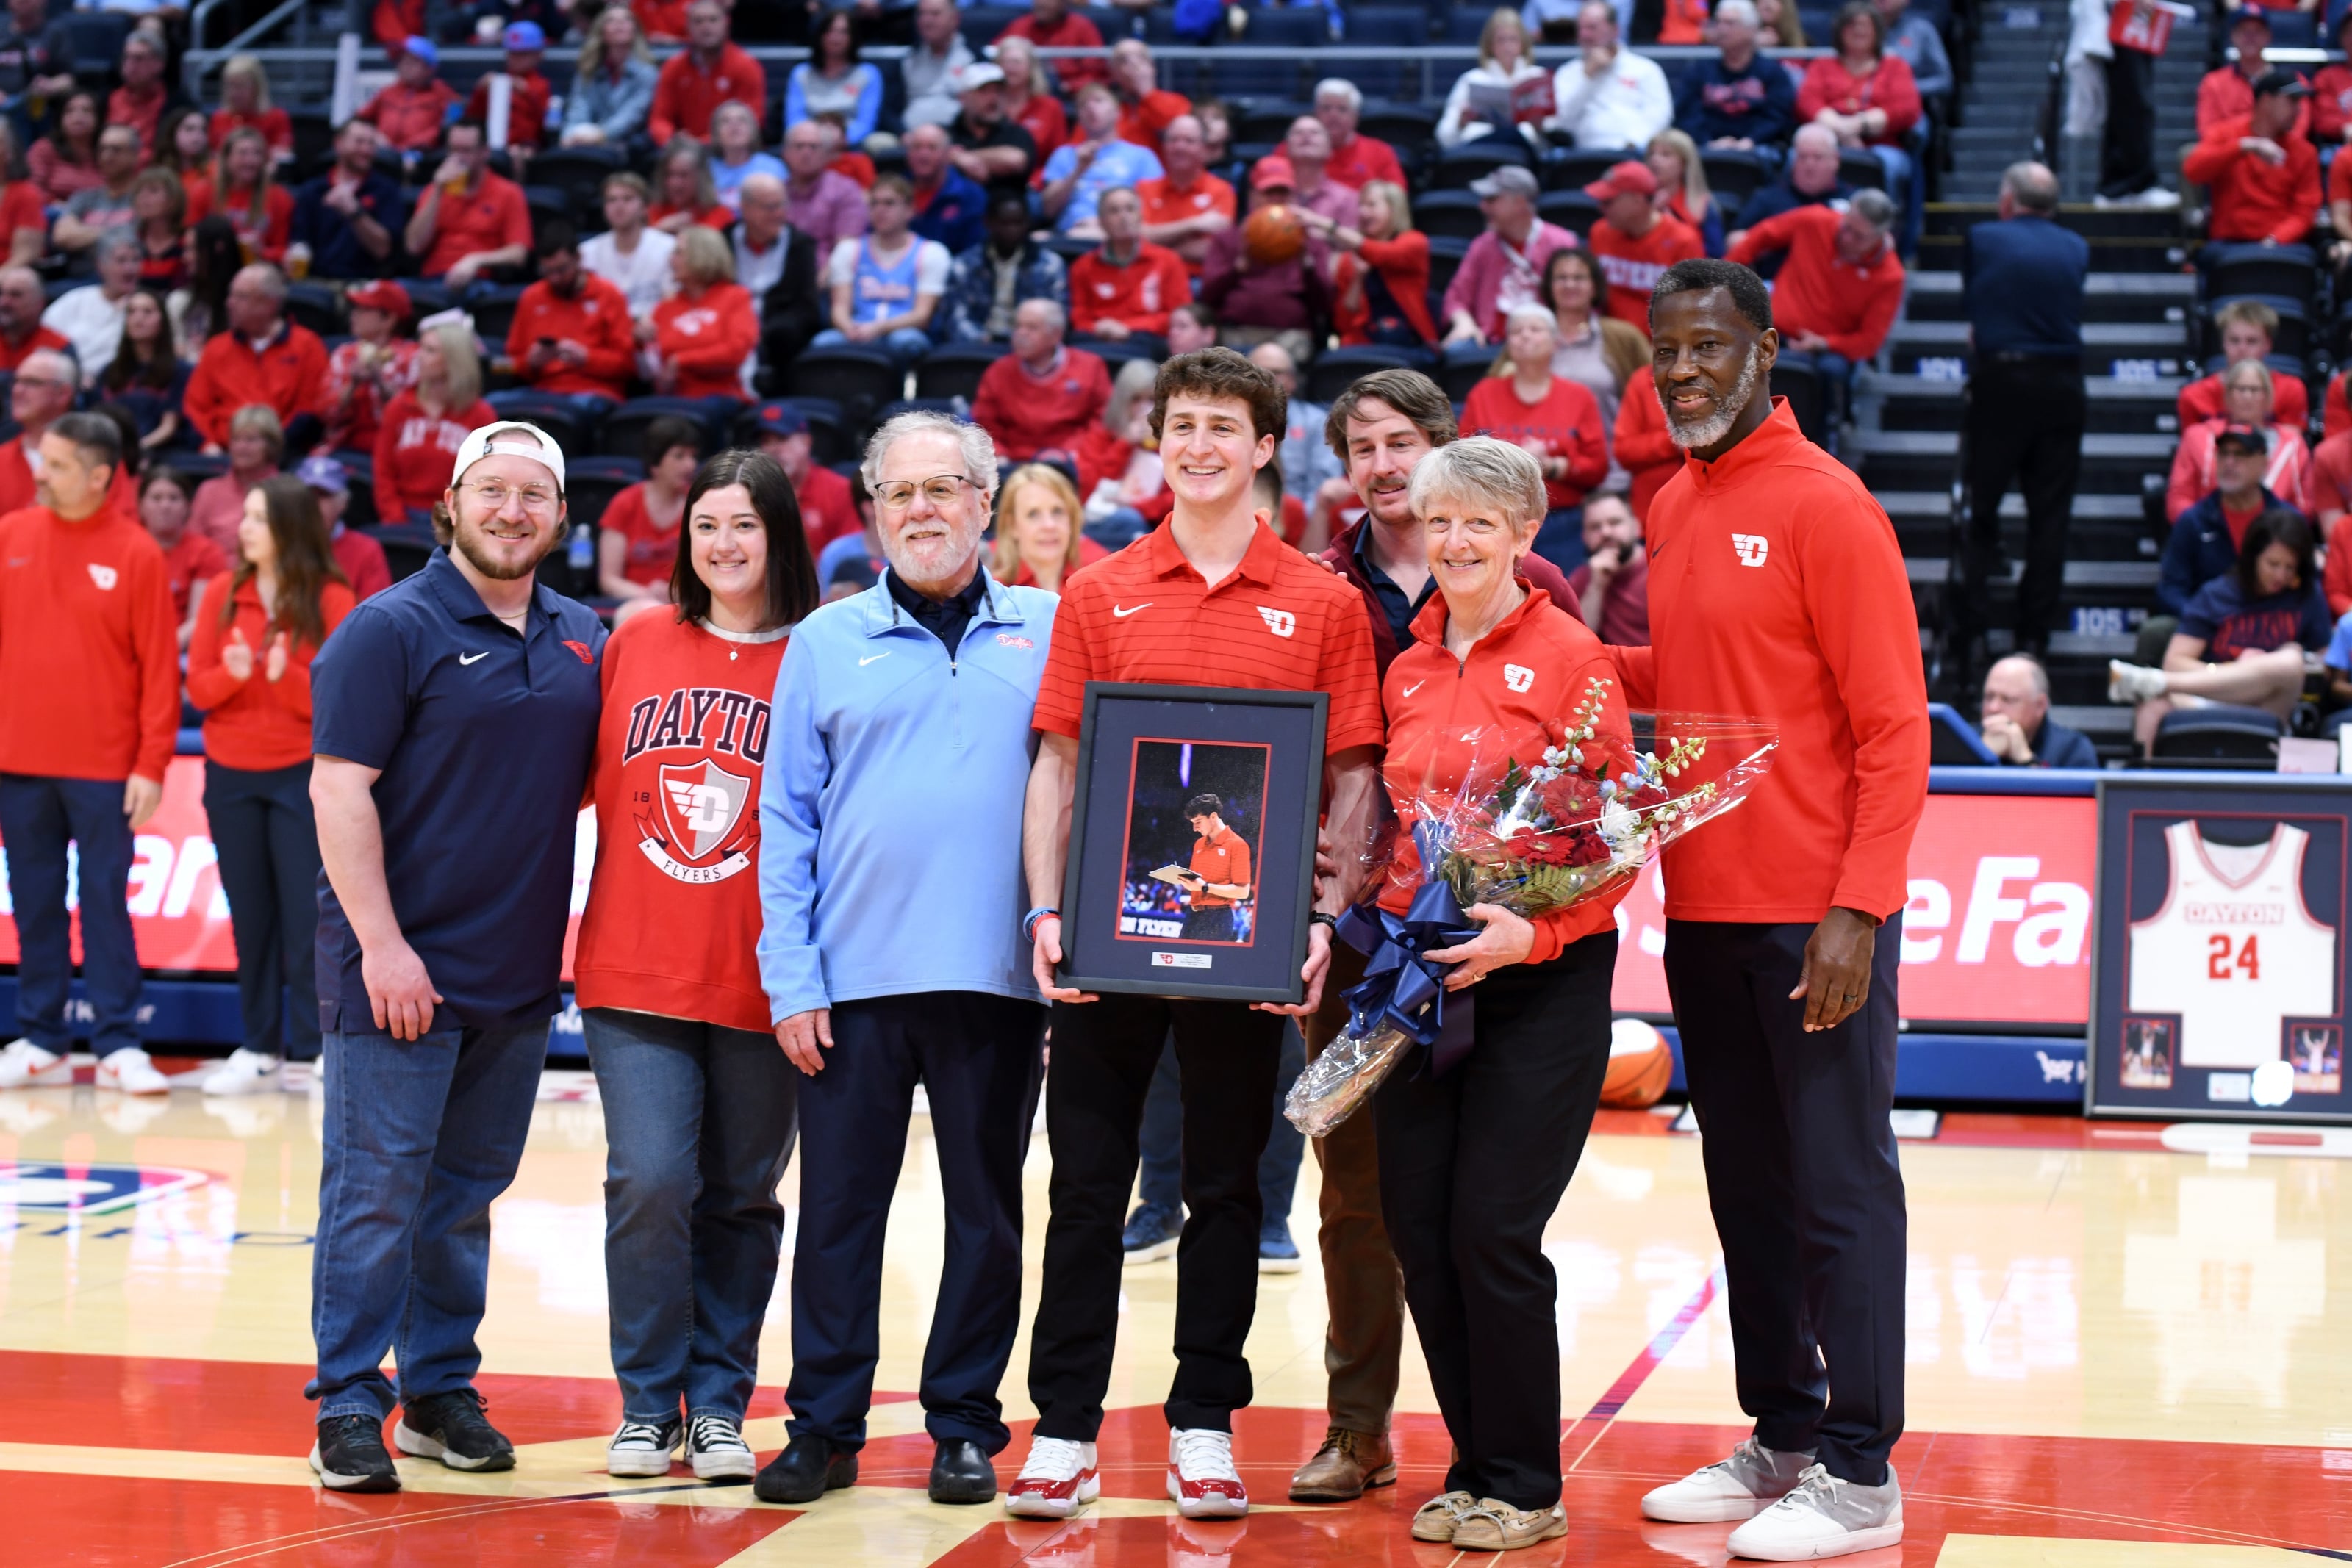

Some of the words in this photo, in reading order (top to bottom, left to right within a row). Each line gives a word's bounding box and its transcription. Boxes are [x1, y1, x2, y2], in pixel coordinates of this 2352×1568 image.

[2077, 607, 2123, 636] 105
[623, 687, 771, 766] DAYTO
[633, 791, 650, 802] 18
[663, 860, 722, 882] FLYERS
[2184, 903, 2284, 925] DAYTON
[2208, 932, 2259, 981] 24
